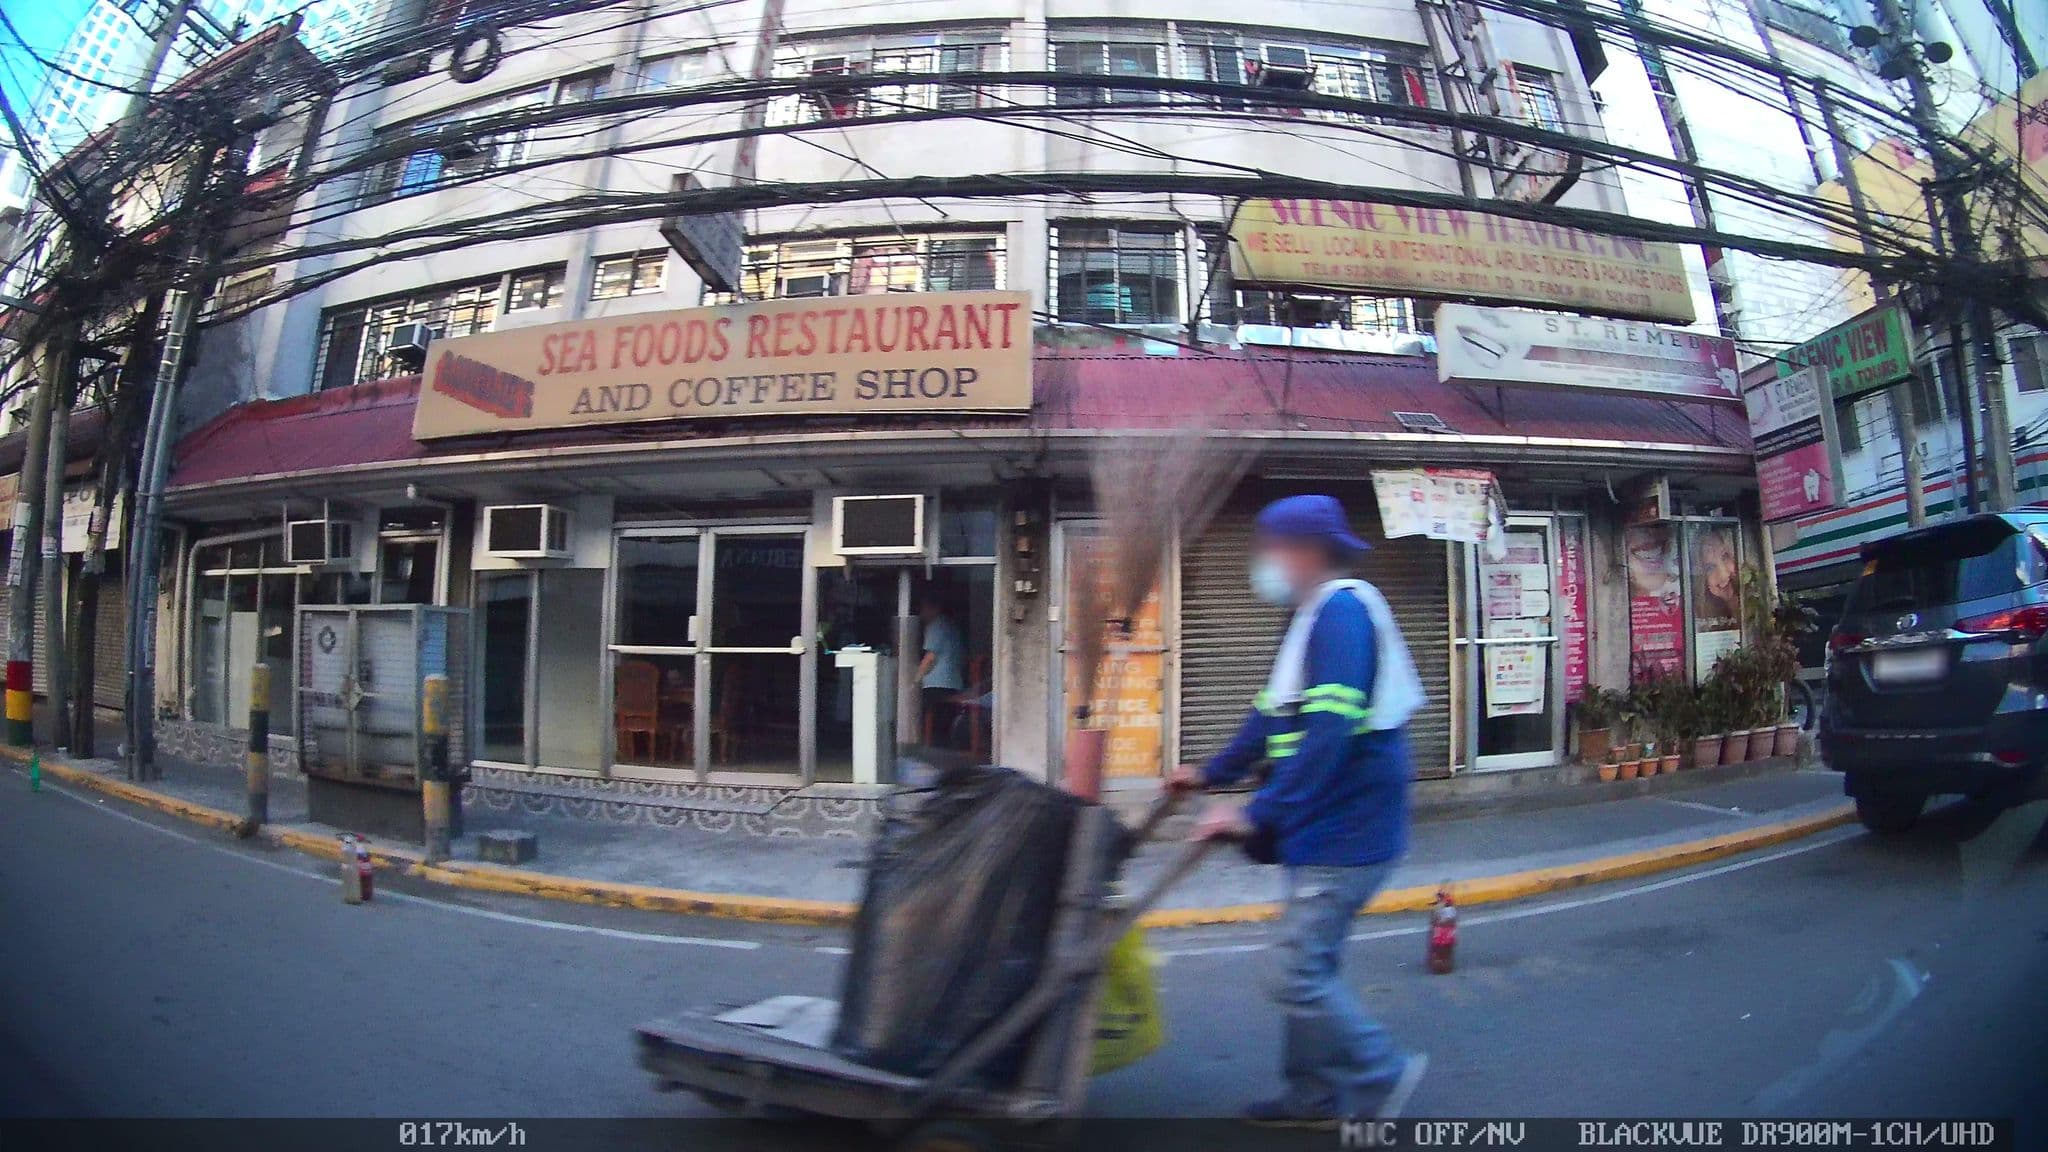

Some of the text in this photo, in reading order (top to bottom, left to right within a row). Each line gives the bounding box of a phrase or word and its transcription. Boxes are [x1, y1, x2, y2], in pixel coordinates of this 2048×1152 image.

[538, 303, 1021, 377] SEA FOODS RESTAURANT
[1845, 319, 1889, 362] VIEW
[569, 383, 652, 416] AND
[667, 371, 837, 409] COFFEE
[854, 367, 980, 400] SHOP
